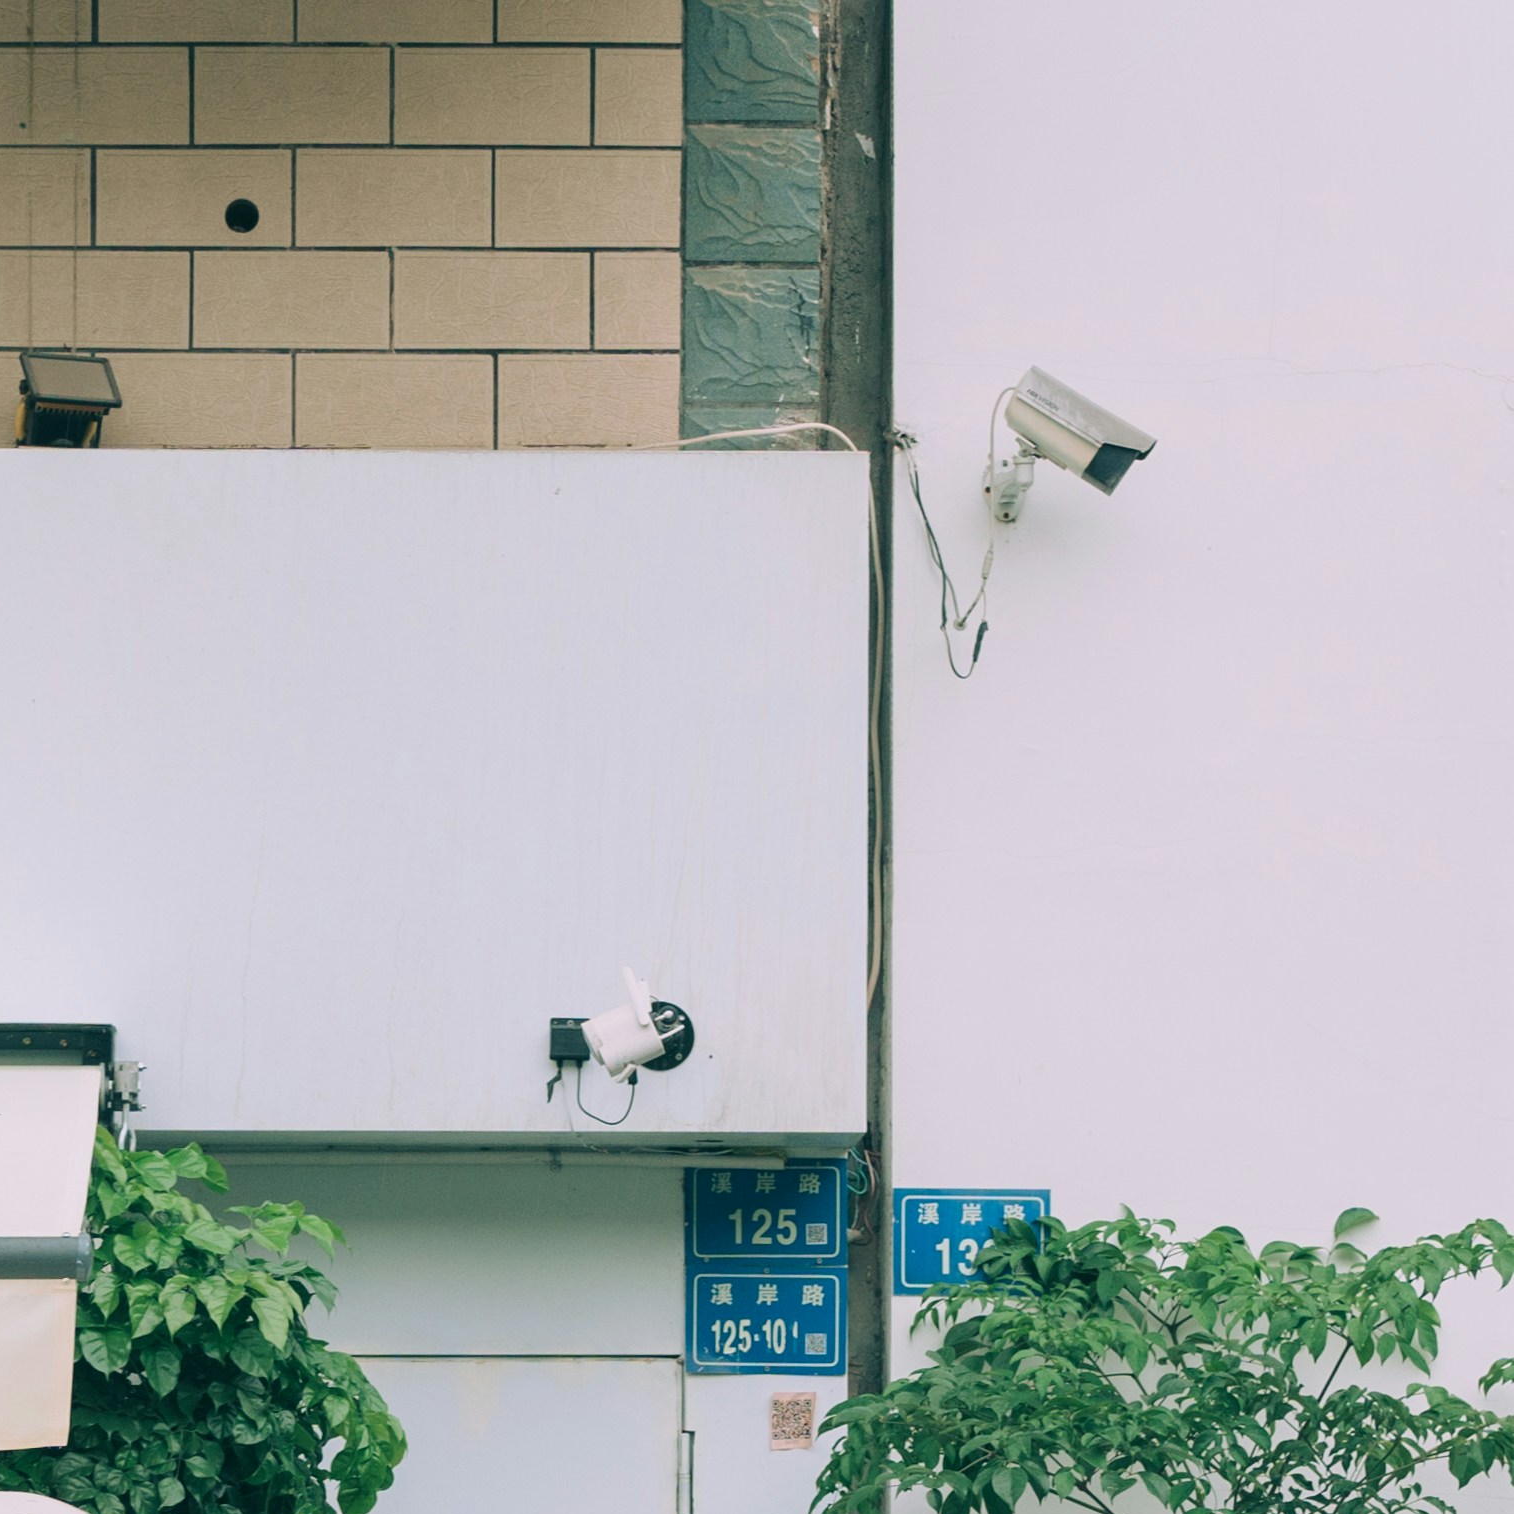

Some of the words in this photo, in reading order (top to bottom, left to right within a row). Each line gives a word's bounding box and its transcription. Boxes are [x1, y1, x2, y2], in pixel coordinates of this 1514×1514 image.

[711, 1172, 821, 1194] 溪岸路
[916, 1202, 1026, 1226] 溪岸路
[728, 1208, 798, 1246] 125
[935, 1238, 996, 1276] 13
[710, 1283, 825, 1306] 溪岸路
